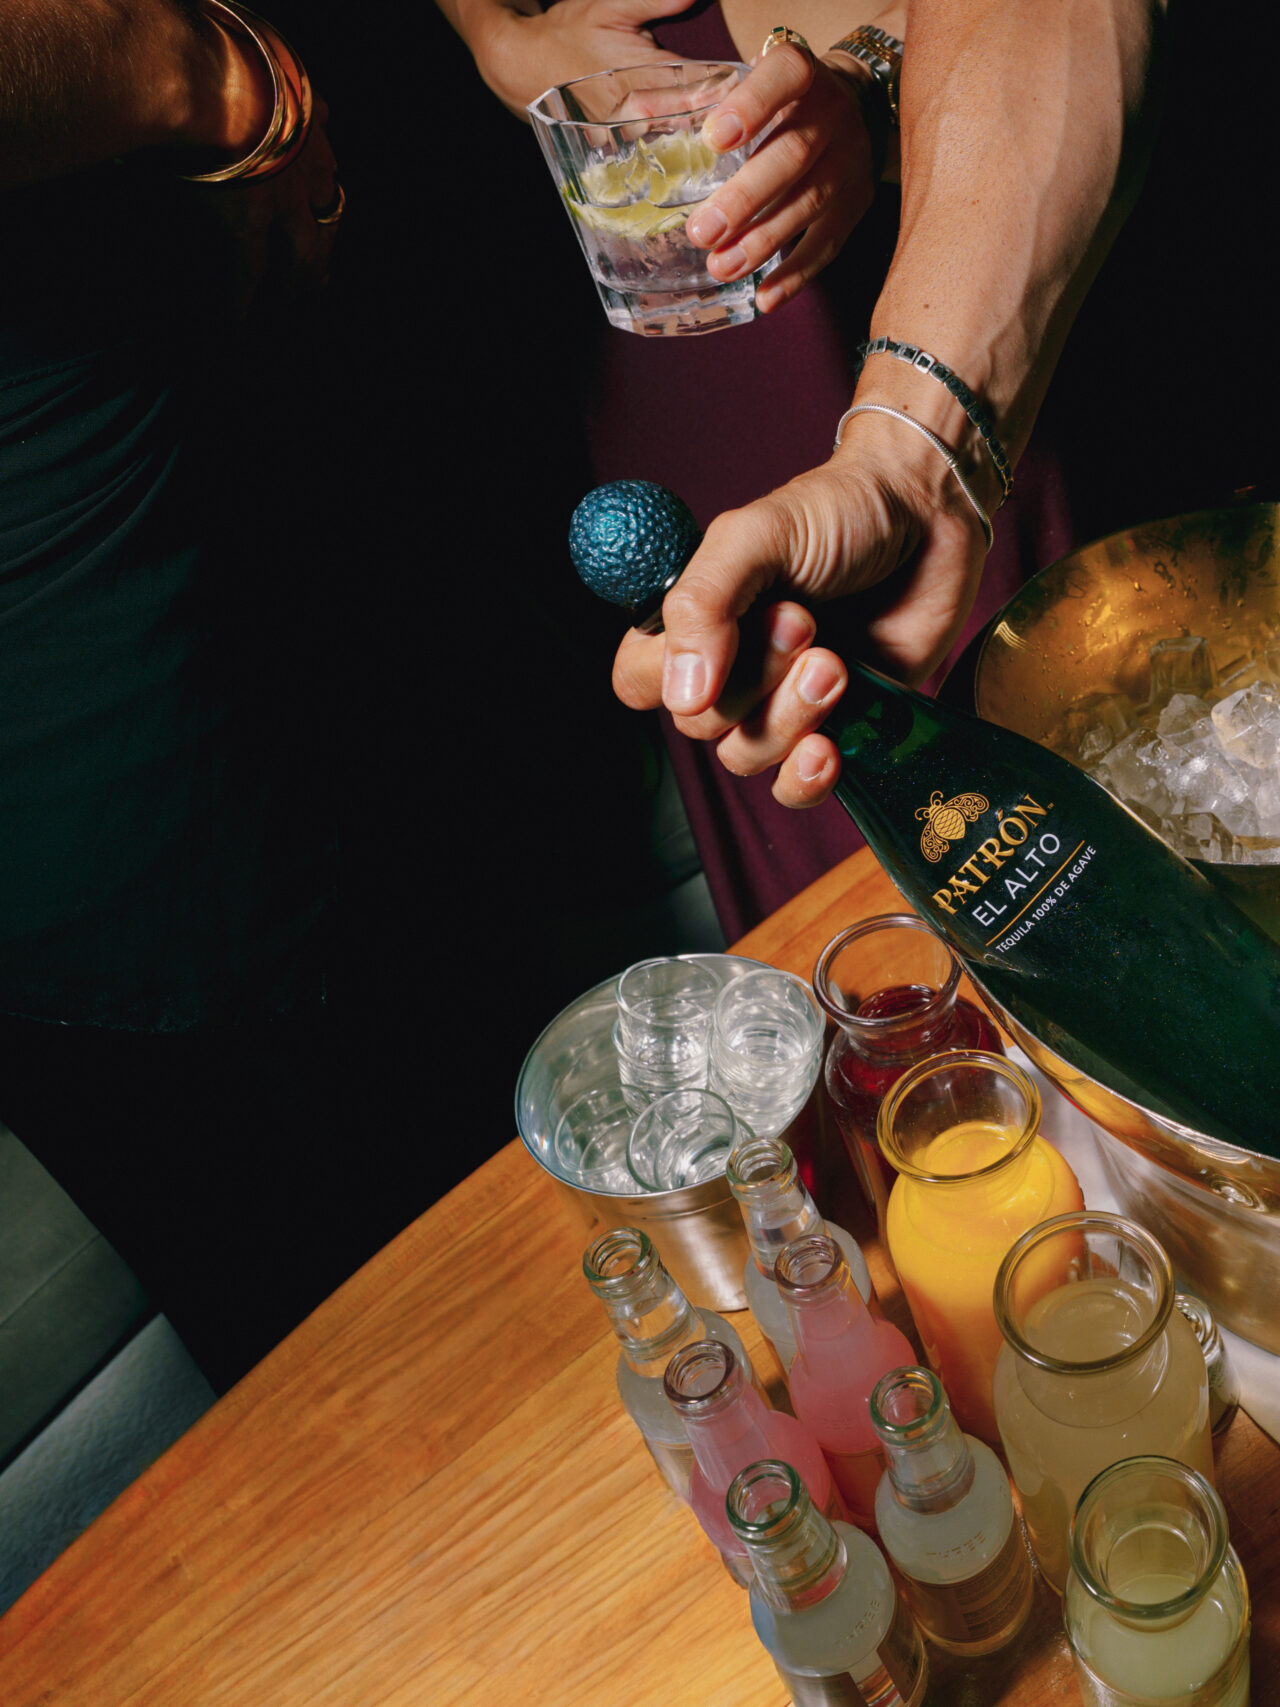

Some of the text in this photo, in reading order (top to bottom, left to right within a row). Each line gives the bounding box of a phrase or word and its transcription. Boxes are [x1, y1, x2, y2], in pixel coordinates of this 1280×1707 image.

[932, 793, 1047, 915] PATRÓN
[972, 833, 1060, 927] EL ALTO
[995, 845, 1097, 953] TEQUILA 100% DE AGAVE
